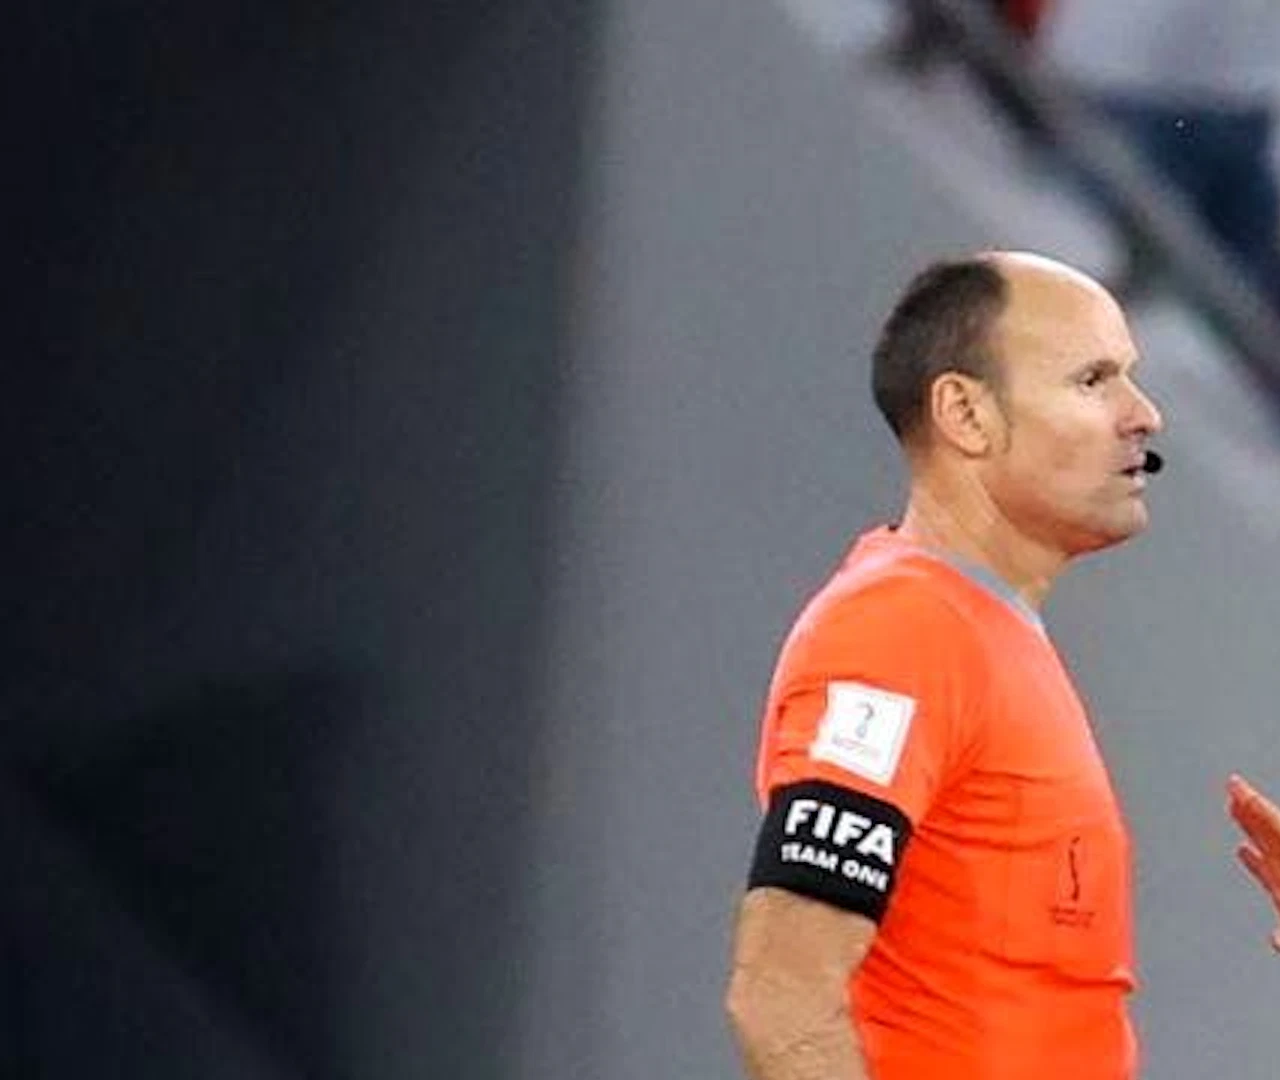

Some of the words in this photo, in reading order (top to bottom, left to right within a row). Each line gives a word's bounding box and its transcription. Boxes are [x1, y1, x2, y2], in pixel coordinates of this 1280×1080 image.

[784, 799, 894, 866] FIFA
[780, 842, 839, 872] TEAM
[841, 859, 889, 892] ONE
